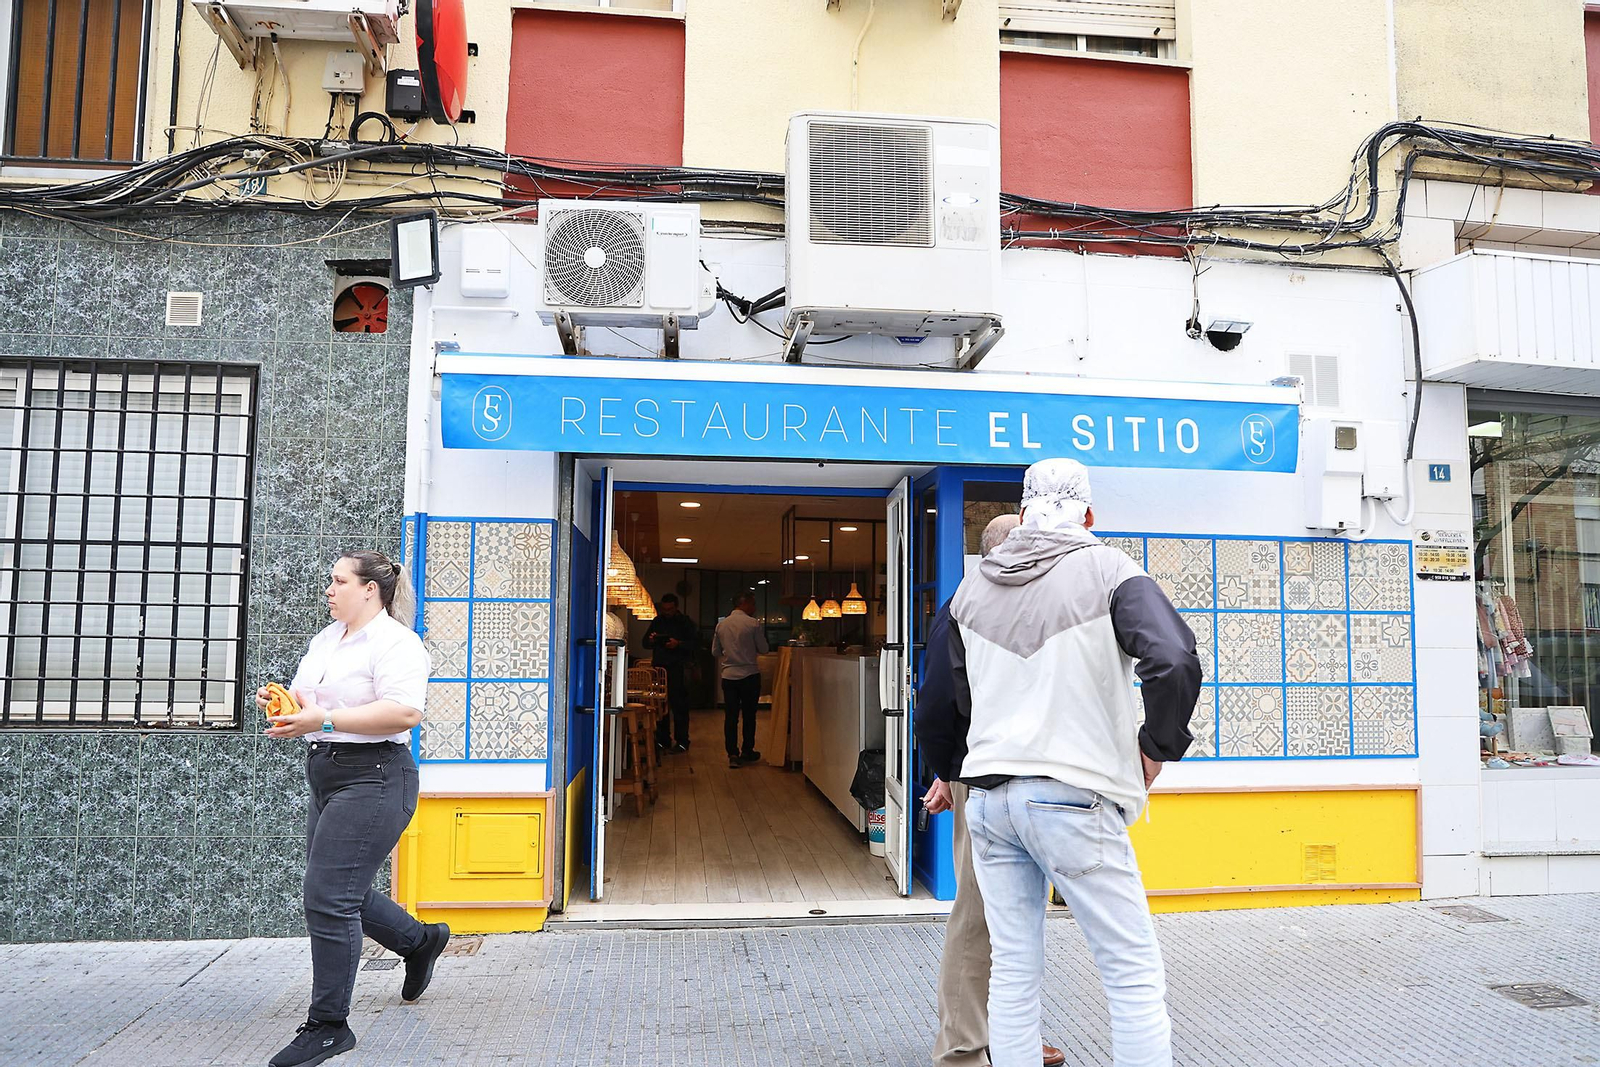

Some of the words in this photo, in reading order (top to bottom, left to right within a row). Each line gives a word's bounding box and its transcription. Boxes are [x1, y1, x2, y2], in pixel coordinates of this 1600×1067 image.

[561, 396, 958, 447] RESTAURANTE
[988, 411, 1042, 449] EL
[1071, 413, 1200, 454] SITIO
[1433, 466, 1446, 480] 14
